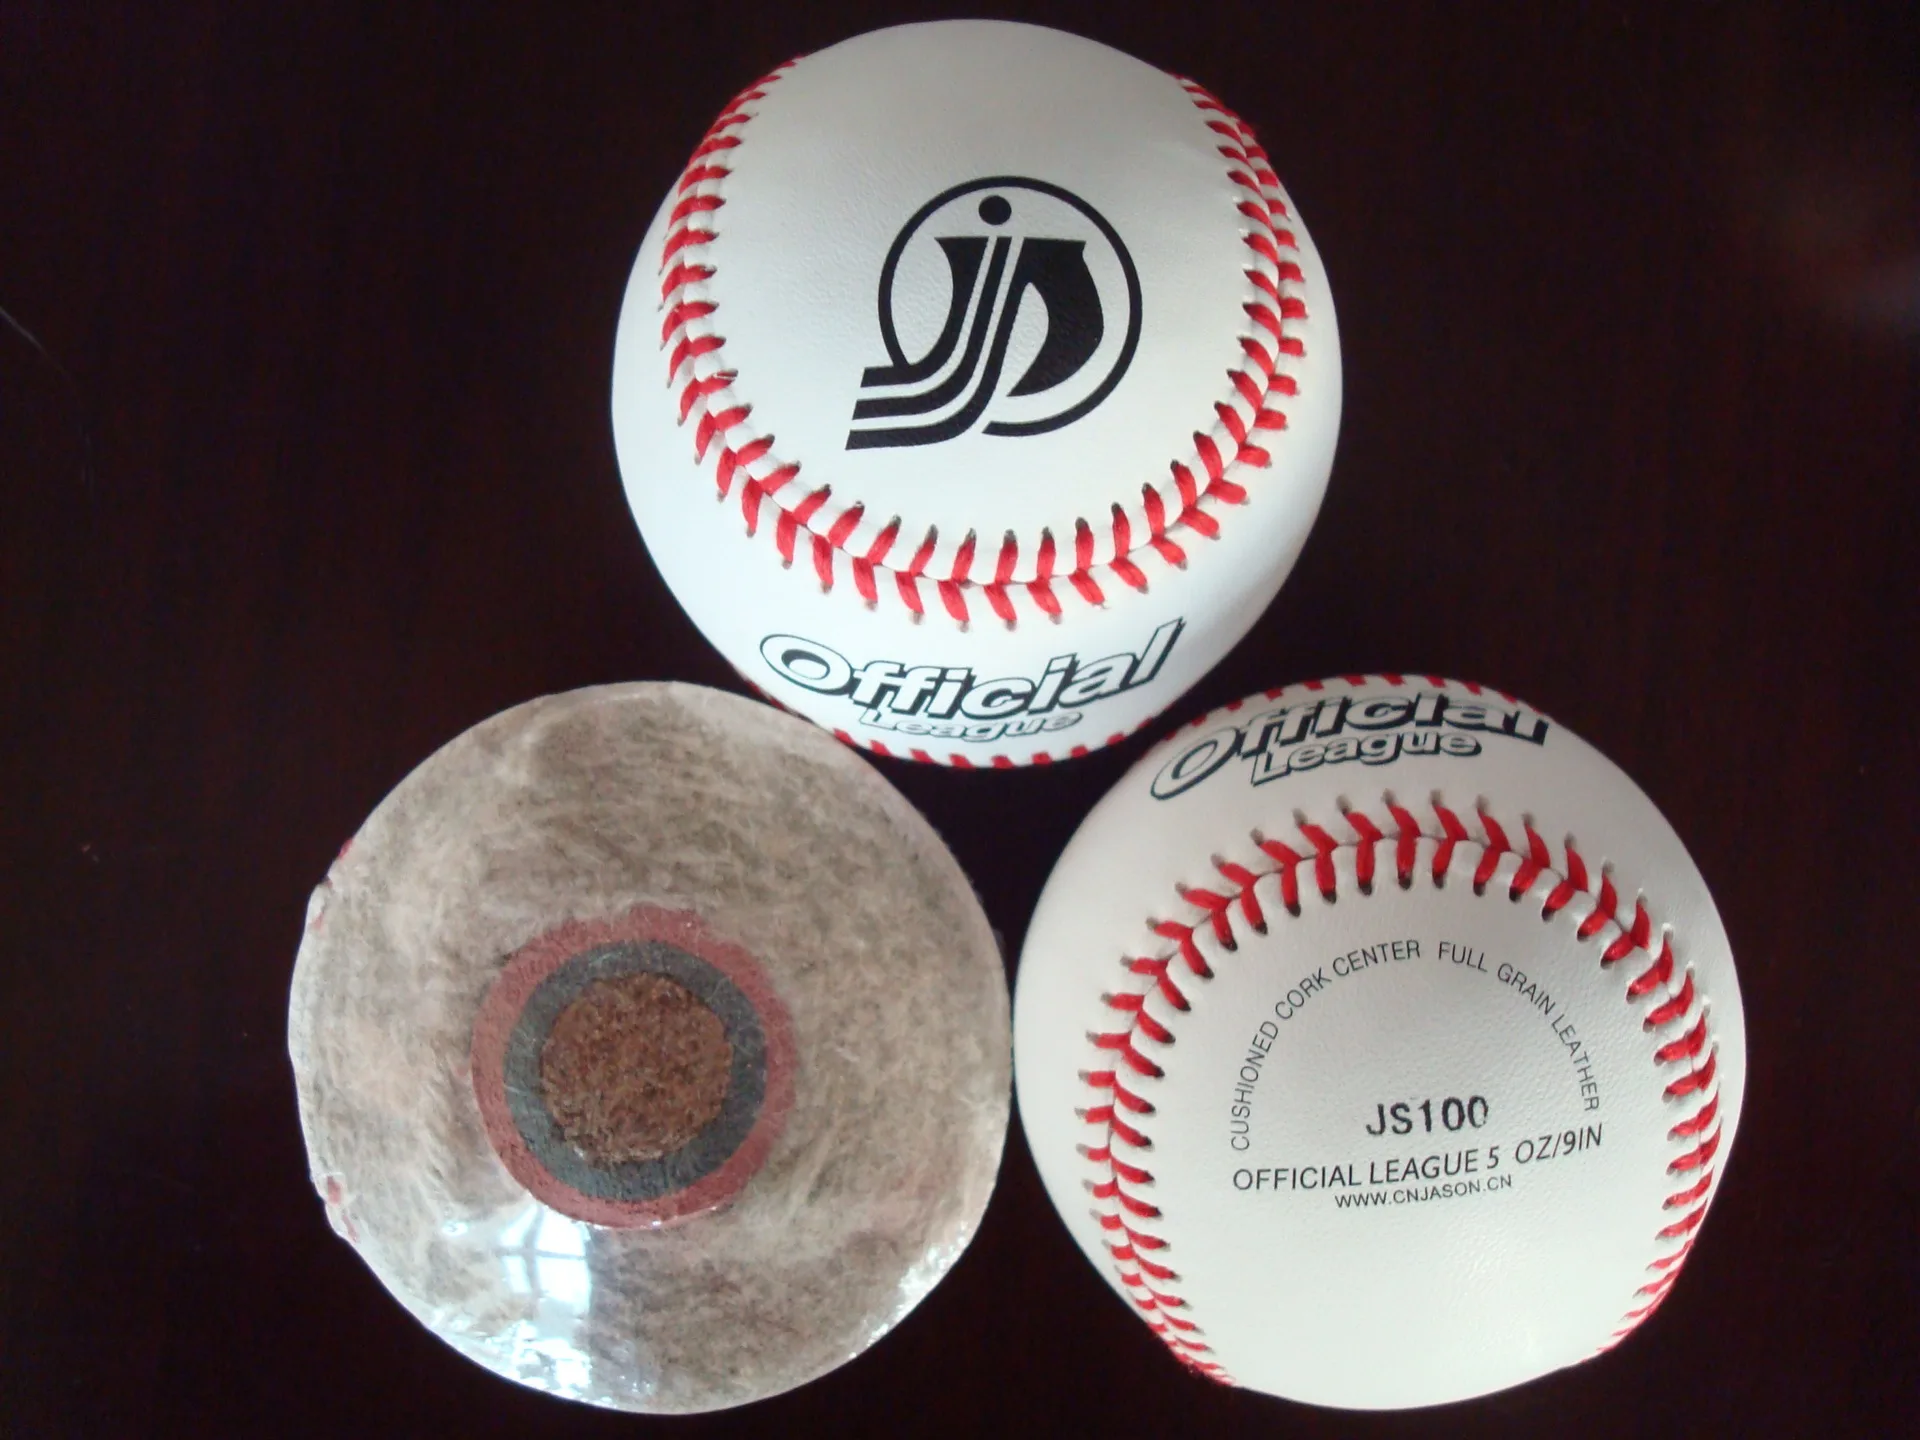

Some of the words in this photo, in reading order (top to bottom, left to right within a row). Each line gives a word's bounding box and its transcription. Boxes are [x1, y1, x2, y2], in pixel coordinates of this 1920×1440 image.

[759, 616, 1187, 720] Official
[859, 709, 1083, 742] League
[1150, 692, 1550, 800] Official
[1250, 730, 1482, 787] League
[1231, 1020, 1279, 1151] CUSHIONED
[1275, 967, 1332, 1020] CORK
[1332, 940, 1420, 977] CENTER
[1438, 941, 1488, 973] FULL
[1497, 963, 1555, 1015] GRAIN
[1551, 1014, 1600, 1112] LEATHER
[1366, 1095, 1489, 1136] JS100
[1233, 1165, 1362, 1191] OFFICIAL
[1369, 1149, 1479, 1185] LEAGUE
[1487, 1146, 1500, 1170] 5
[1515, 1123, 1603, 1164] OZ/9IN
[1334, 1174, 1513, 1208] WWW.CNJASON.CN
